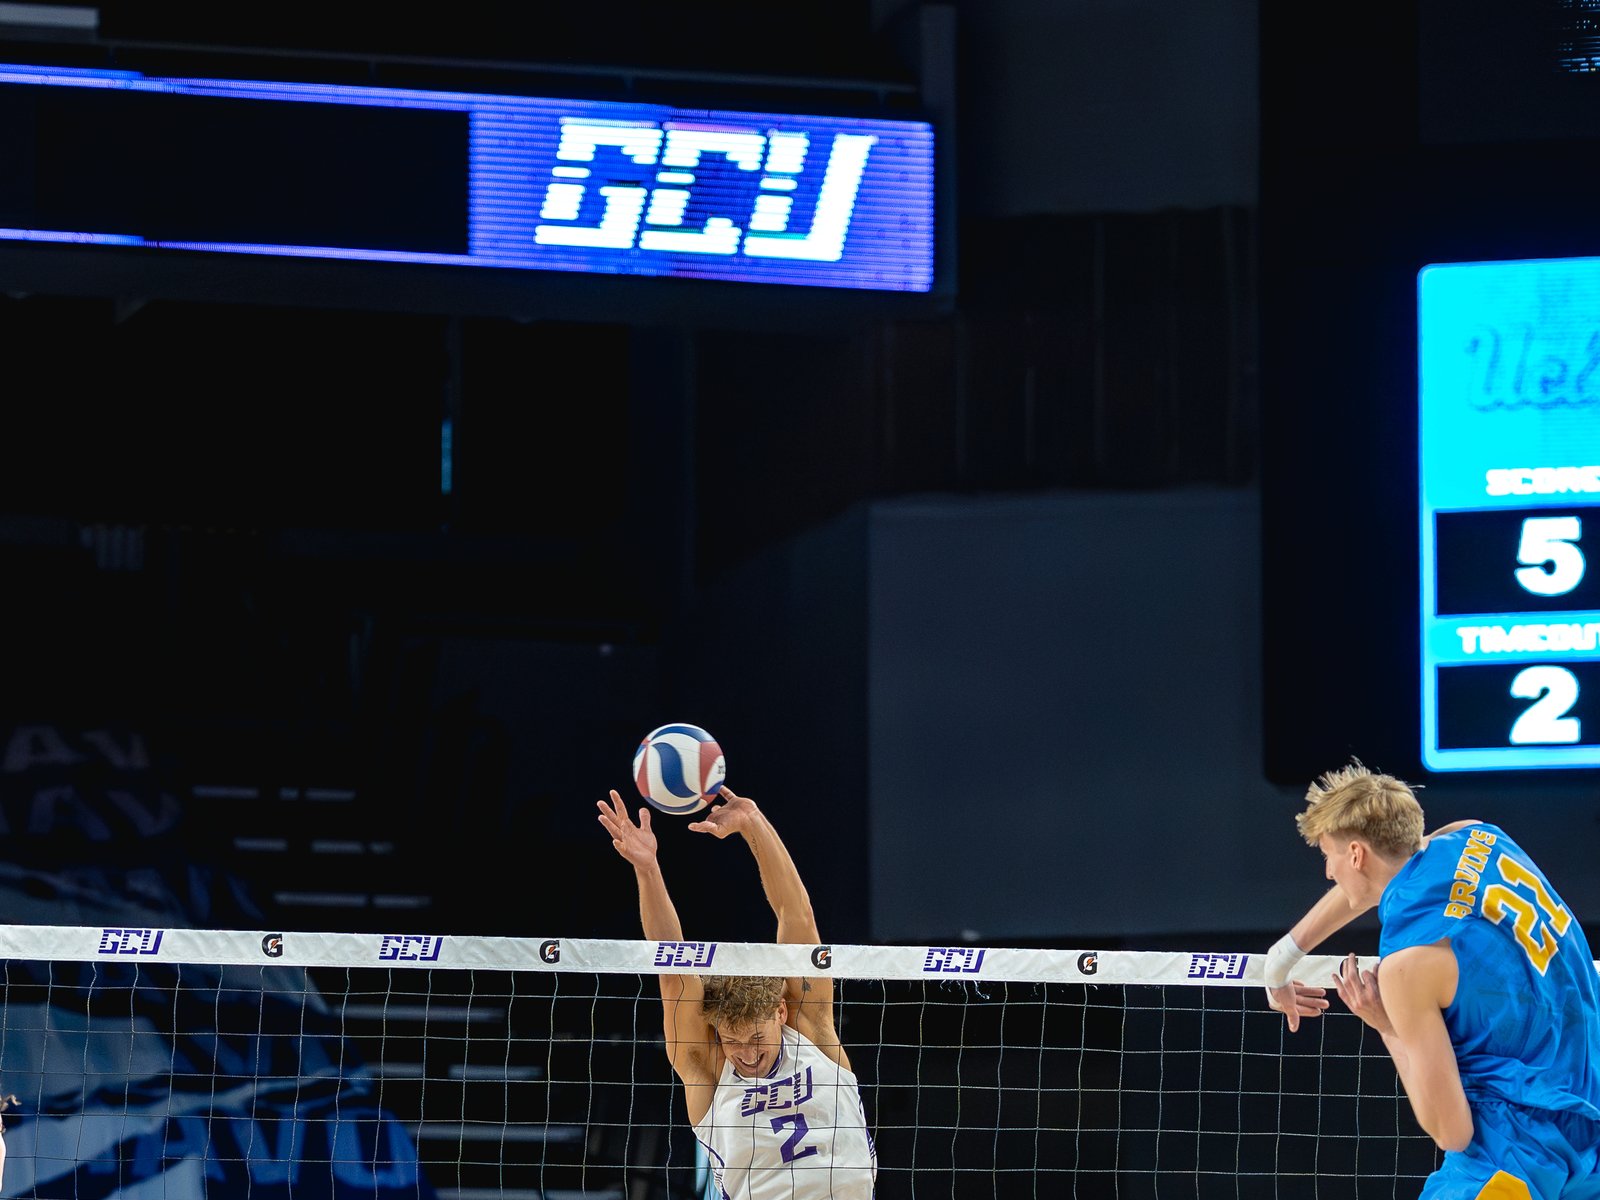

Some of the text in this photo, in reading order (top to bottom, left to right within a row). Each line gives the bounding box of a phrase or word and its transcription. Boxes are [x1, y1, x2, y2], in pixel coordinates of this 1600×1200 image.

[535, 117, 878, 262] GCU
[1515, 516, 1586, 596] 5
[1456, 622, 1600, 655] TIMEOU
[1509, 665, 1581, 745] 2
[1443, 828, 1498, 920] BRUINS
[1481, 852, 1573, 977] 21
[98, 929, 163, 955] GCU
[261, 933, 283, 958] G
[378, 935, 444, 961] GCU
[539, 939, 561, 964] G
[653, 942, 717, 968] GCU
[810, 945, 832, 970] G
[923, 948, 985, 973] GCU
[1077, 951, 1098, 976] G
[1187, 954, 1249, 980] GCU
[741, 1065, 813, 1118] GCU
[769, 1112, 818, 1165] 2
